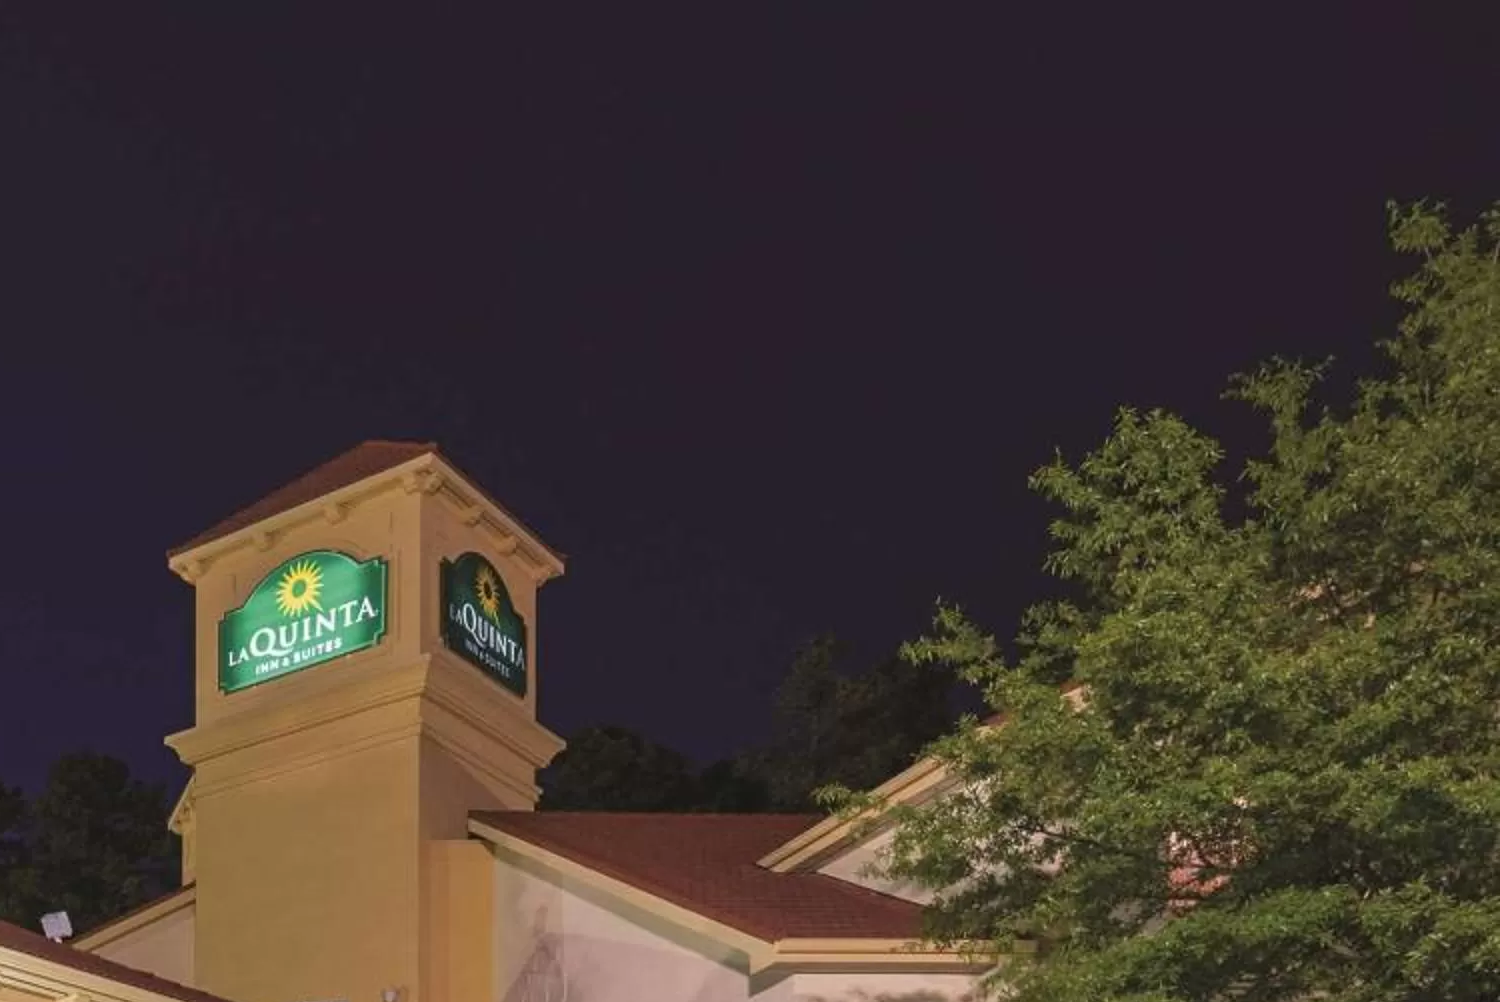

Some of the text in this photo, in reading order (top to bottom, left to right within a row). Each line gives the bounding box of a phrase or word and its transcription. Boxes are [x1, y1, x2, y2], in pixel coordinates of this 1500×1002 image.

[250, 596, 377, 657] QUINTA
[255, 637, 343, 675] INN & SUITES
[463, 603, 526, 671] QUINTA
